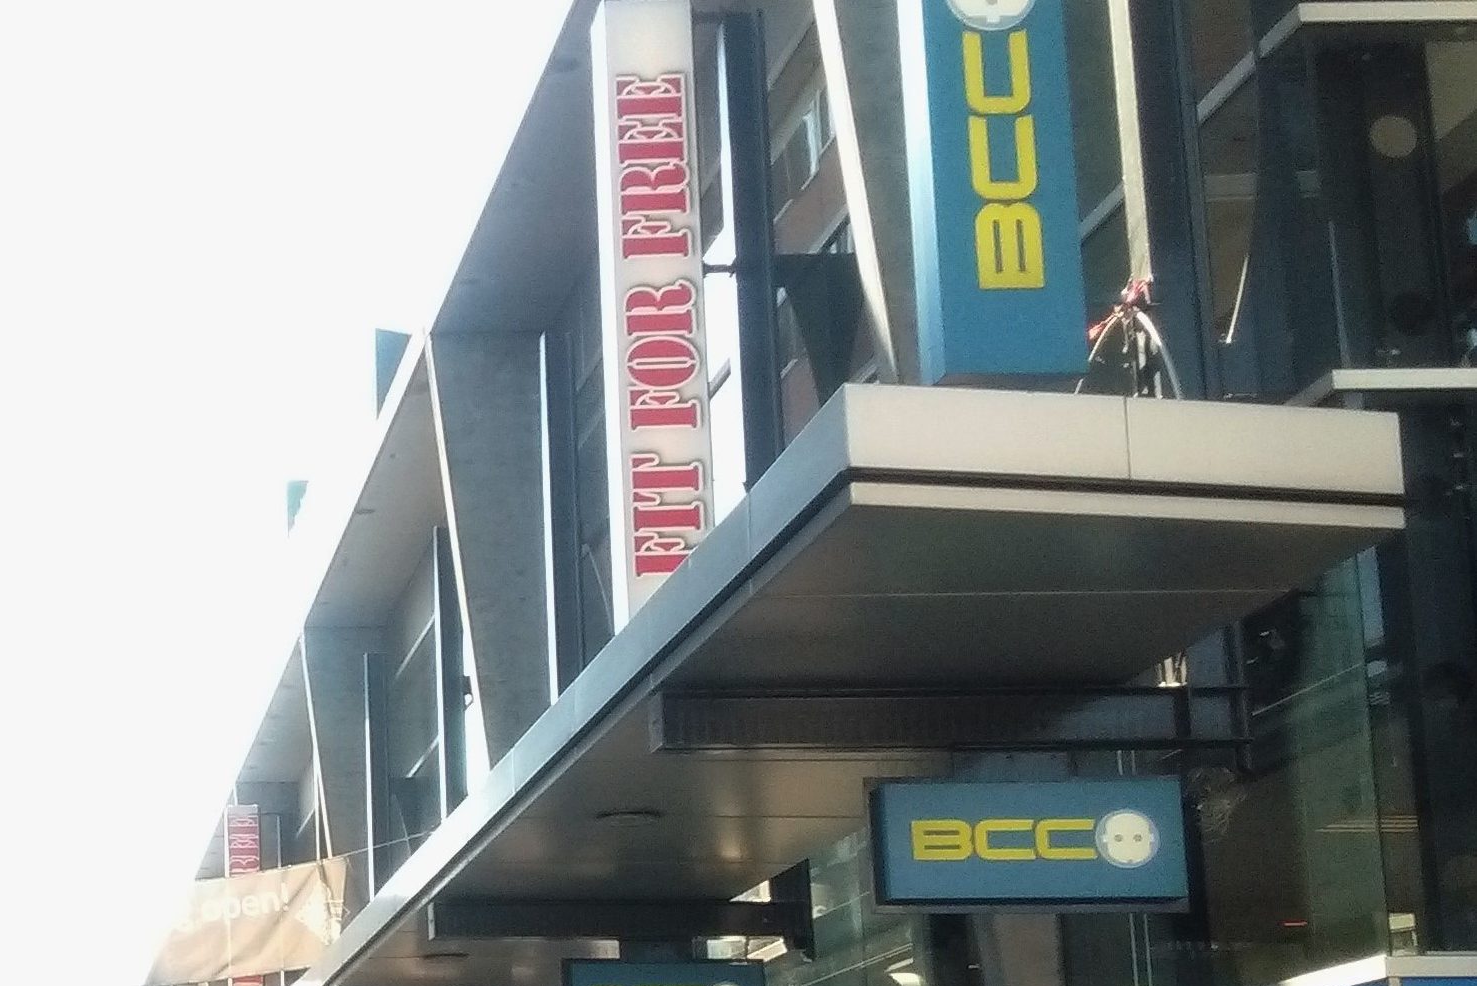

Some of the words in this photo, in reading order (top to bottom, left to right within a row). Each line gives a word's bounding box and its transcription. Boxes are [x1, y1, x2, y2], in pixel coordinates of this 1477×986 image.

[615, 73, 691, 259] FREE
[961, 29, 1046, 290] BCC
[624, 279, 701, 430] FOR
[630, 452, 703, 578] FIT
[910, 818, 1098, 862] BCC
